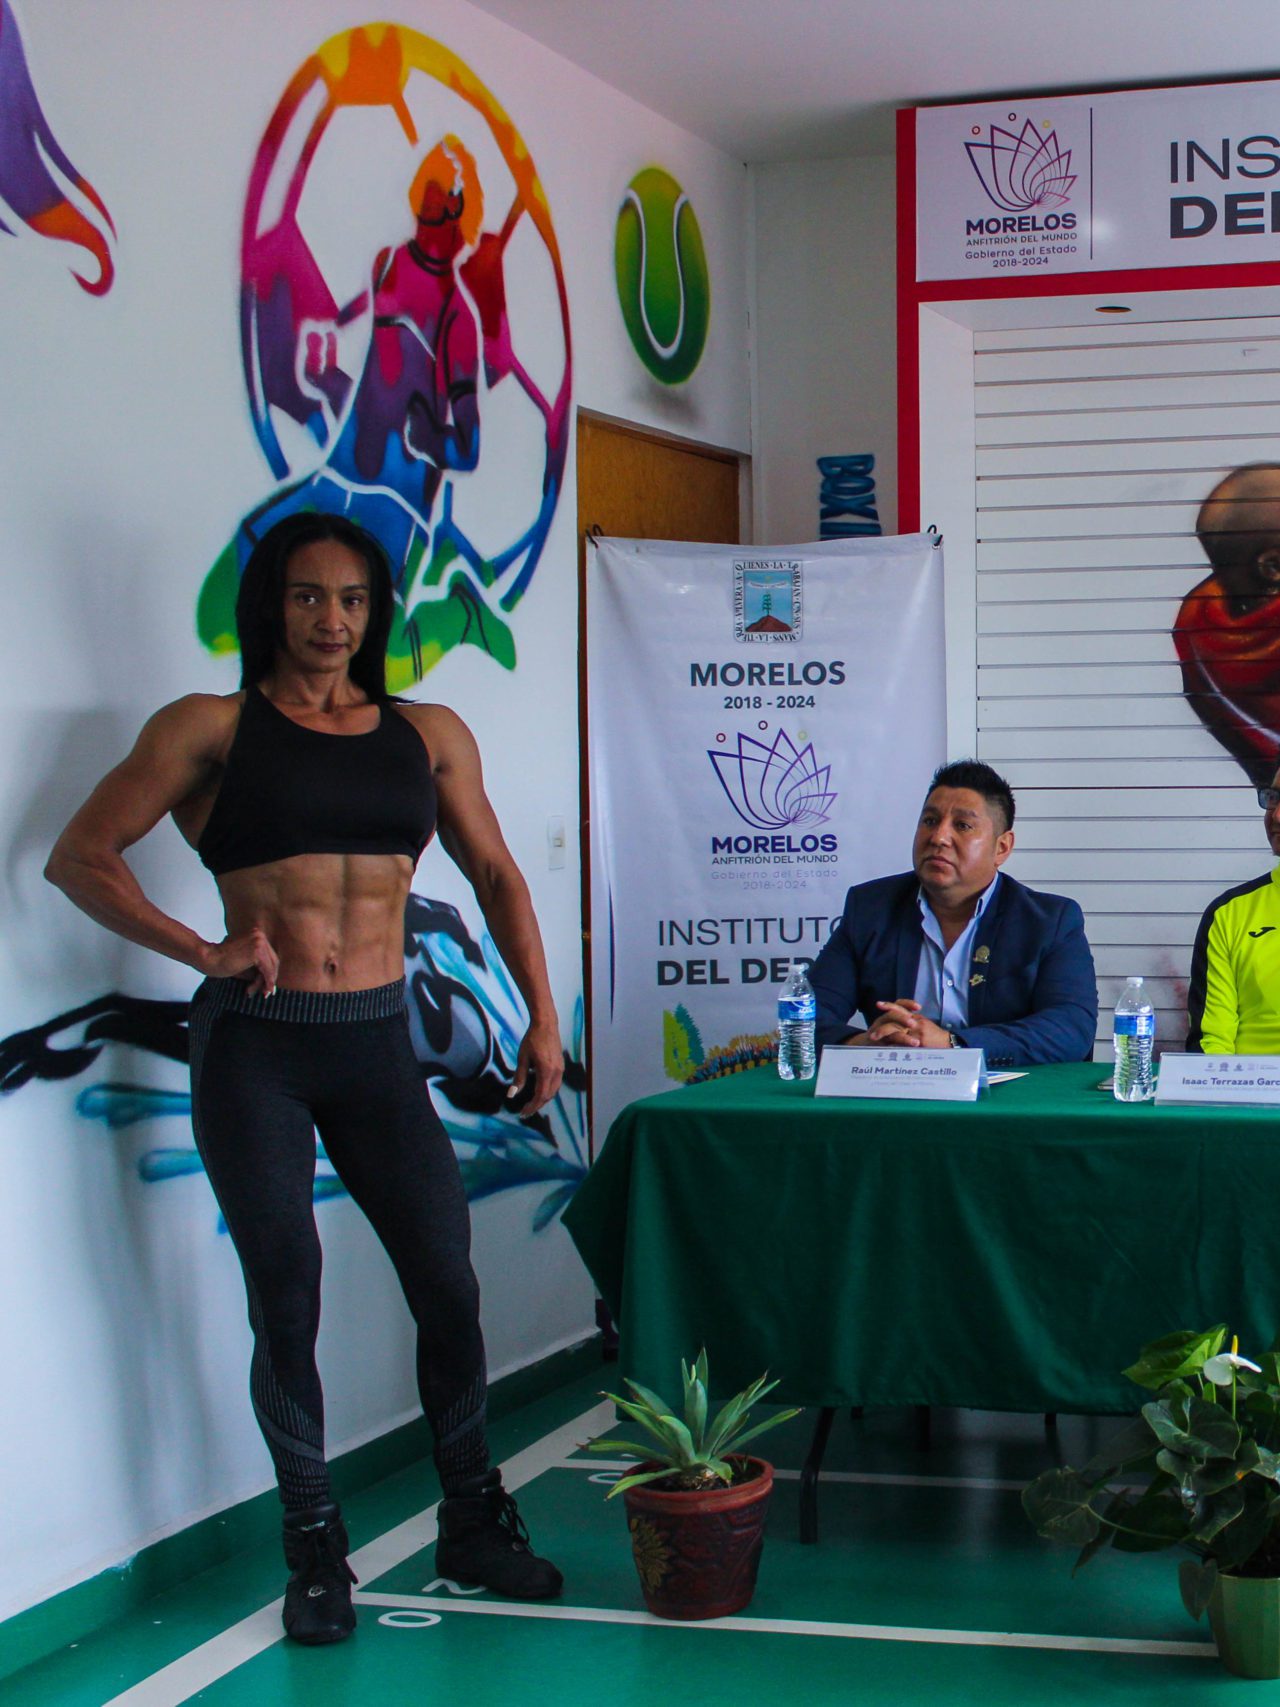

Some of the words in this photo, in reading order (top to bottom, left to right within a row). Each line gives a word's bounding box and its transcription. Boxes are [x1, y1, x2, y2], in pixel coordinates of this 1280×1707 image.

[965, 213, 1077, 236] MORELOS
[966, 235, 1018, 246] ANFITRIÓN
[1020, 235, 1039, 243] DEL
[1041, 232, 1078, 242] MUNDO
[965, 249, 1015, 260] Gobierno
[1018, 247, 1035, 256] del
[1039, 244, 1077, 254] Estado
[992, 257, 1049, 268] 2018-2024
[690, 661, 846, 687] MORELOS
[723, 696, 762, 709] 2018
[776, 695, 816, 709] 2024
[711, 834, 838, 854] MORELOS
[711, 853, 771, 865] ANFITRIÓN
[773, 856, 794, 864] DEL
[796, 854, 838, 863] MUNDO
[711, 870, 768, 880] Gobierno
[772, 869, 792, 879] del
[796, 868, 839, 878] Estado
[743, 880, 808, 890] 2018-2024
[657, 959, 730, 986] DEL
[850, 1066, 873, 1075] Raúl
[920, 1067, 958, 1076] Castillo
[1182, 1077, 1208, 1085] Isaac
[1210, 1077, 1255, 1086] Terrazas
